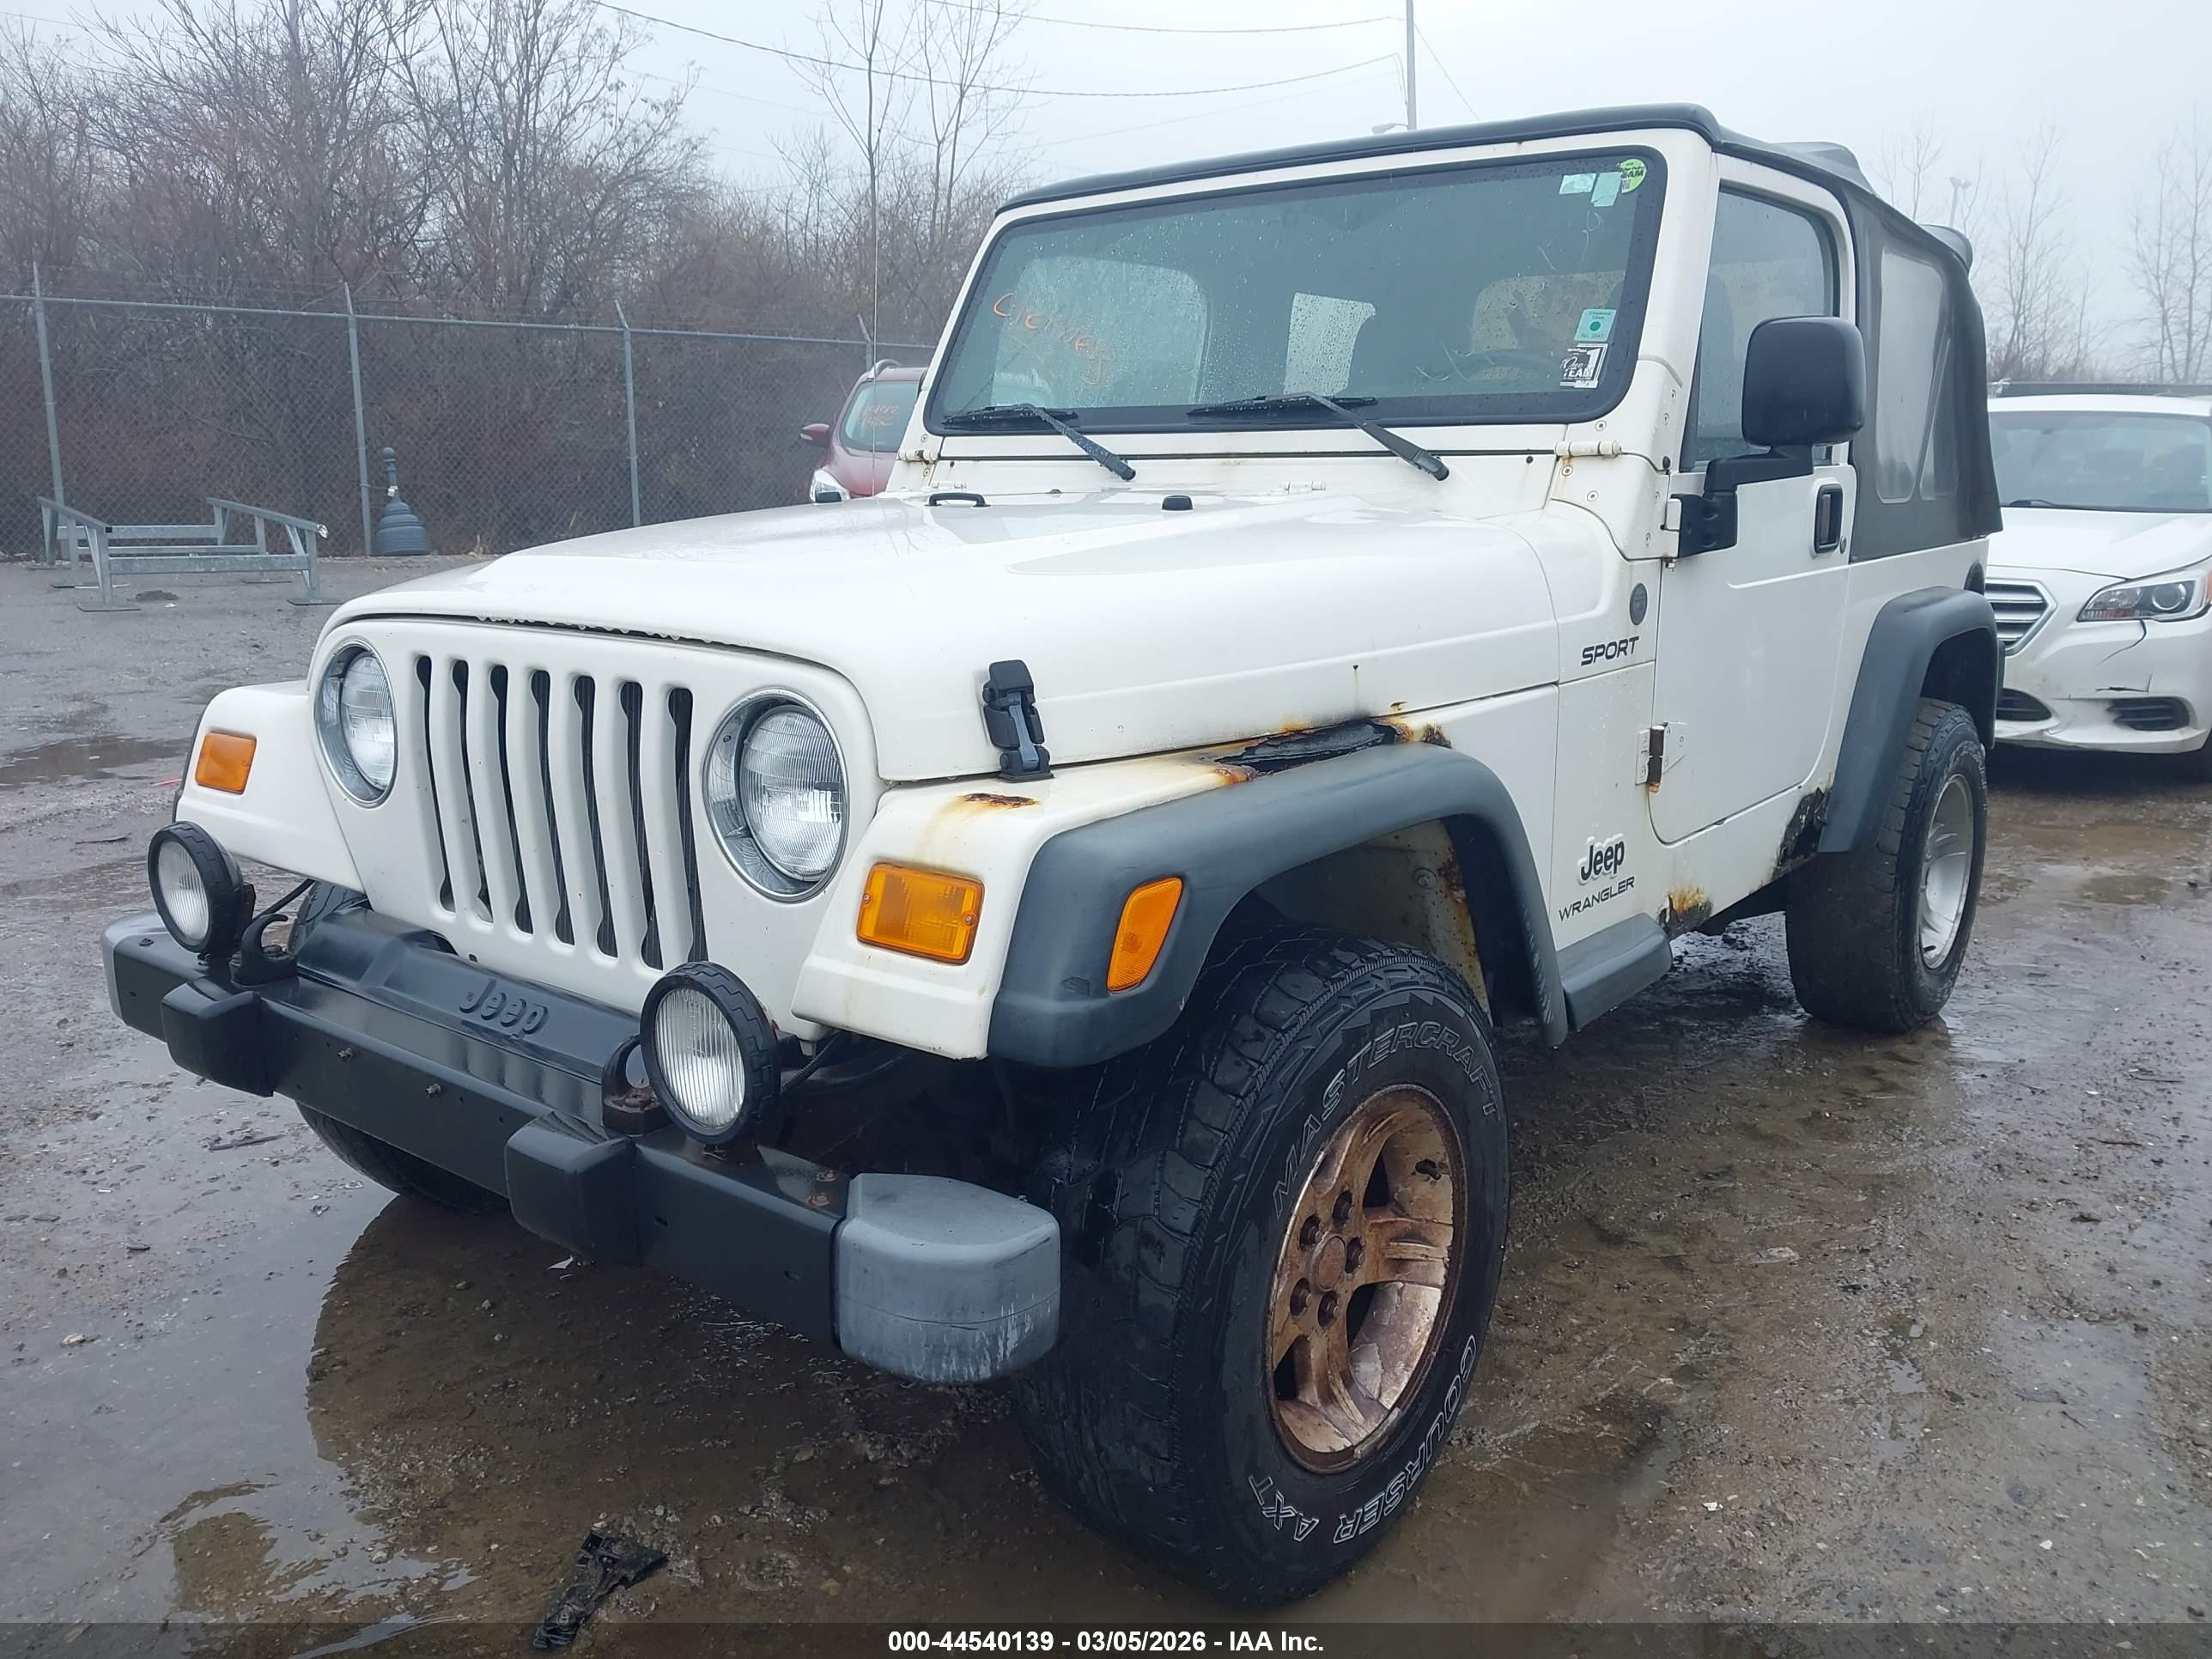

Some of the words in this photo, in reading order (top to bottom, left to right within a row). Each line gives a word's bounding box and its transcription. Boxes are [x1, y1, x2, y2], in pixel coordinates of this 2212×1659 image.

[1580, 635, 1640, 666] SPORT
[1580, 841, 1625, 881] Jeep
[1559, 876, 1635, 921] WRANGLER
[459, 979, 550, 1038] Jeep
[1273, 1021, 1502, 1220] MASTERCRAFT
[1334, 1334, 1477, 1544] COURSER
[1249, 1474, 1319, 1542] AXT
